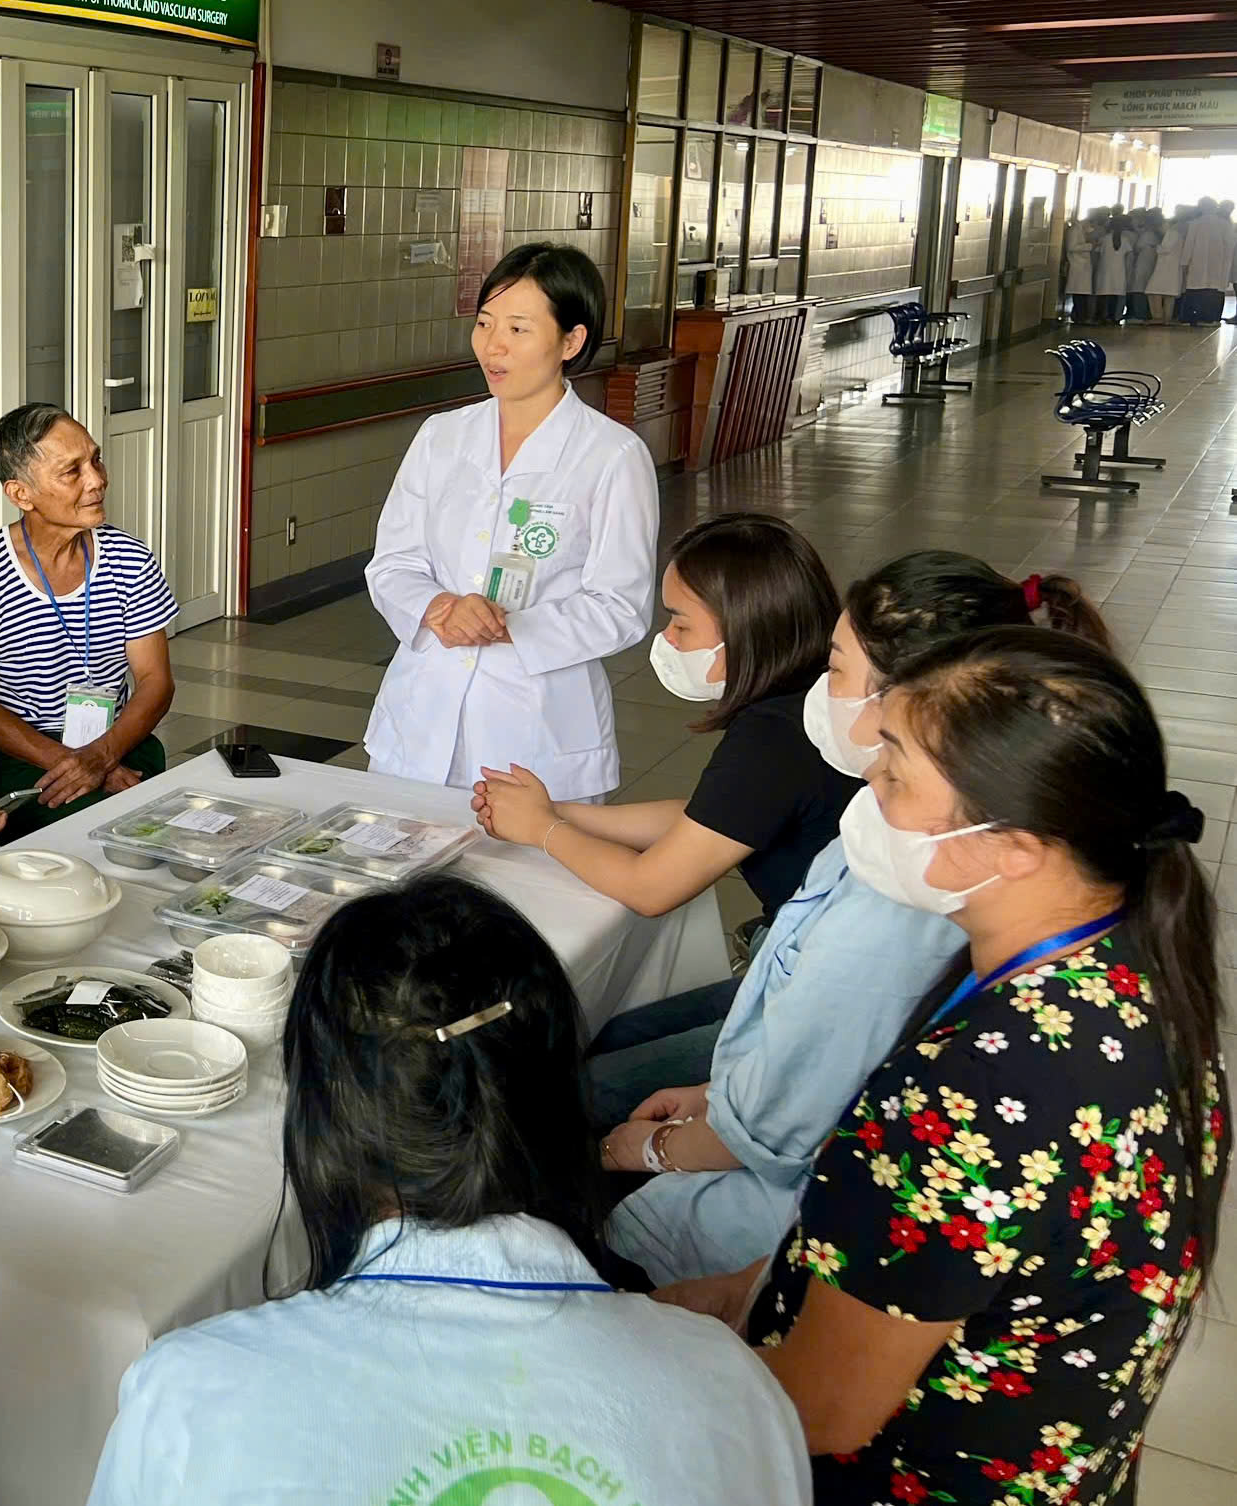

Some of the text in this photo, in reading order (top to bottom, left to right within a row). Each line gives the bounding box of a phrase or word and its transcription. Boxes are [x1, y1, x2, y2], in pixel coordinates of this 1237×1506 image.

[142, 0, 160, 14] AND
[160, 2, 196, 20] VASCULAR
[197, 8, 228, 26] SURGERY
[431, 1424, 513, 1471] VIỆN
[528, 1432, 624, 1500] BẠCH
